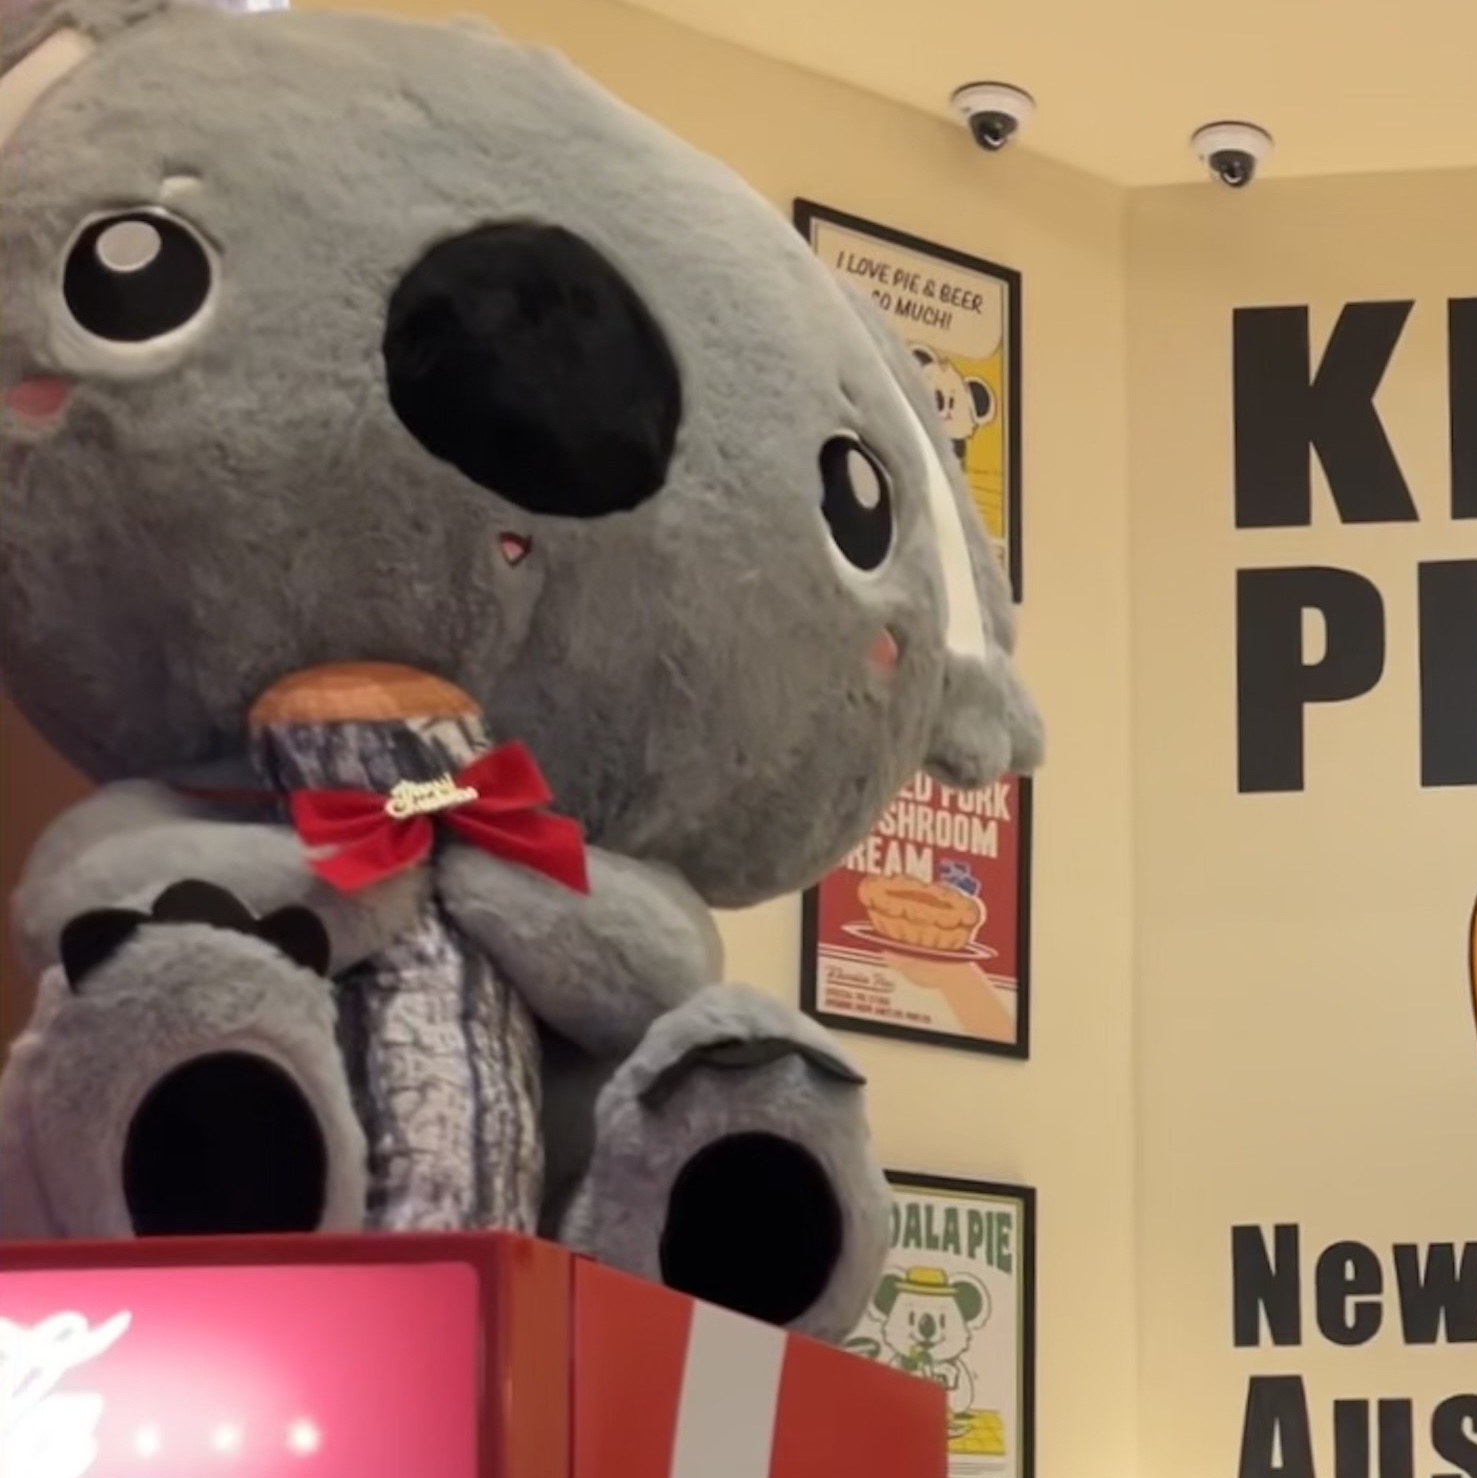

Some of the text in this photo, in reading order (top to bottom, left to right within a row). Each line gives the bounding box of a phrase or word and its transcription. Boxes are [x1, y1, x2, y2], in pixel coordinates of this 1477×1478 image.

[836, 251, 984, 314] I LOVE PIE & BEER
[894, 296, 953, 330] MUCH!
[877, 801, 998, 859] SHROOM
[843, 835, 933, 886] REAM
[967, 1209, 1012, 1275] PIE
